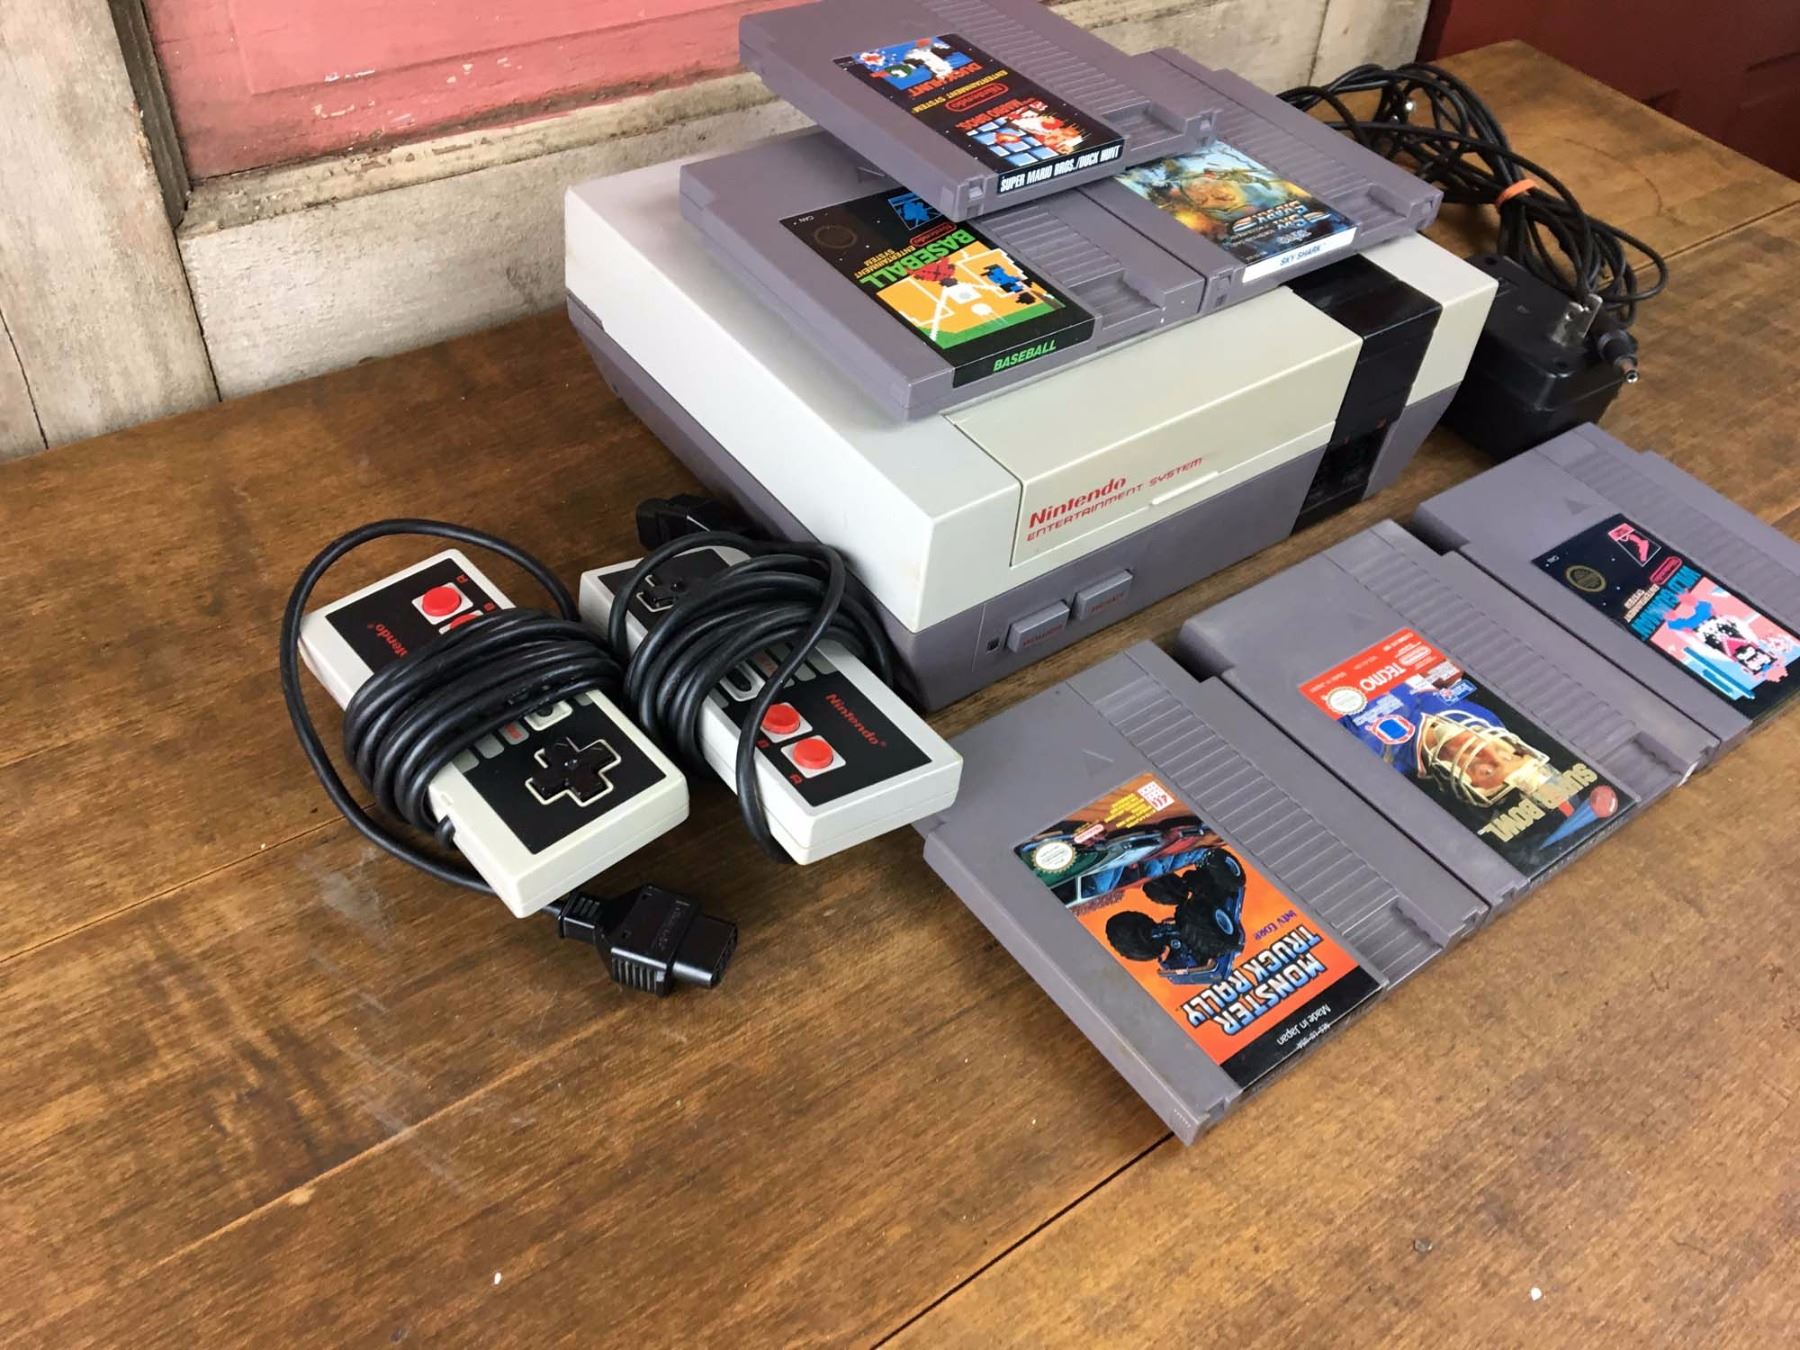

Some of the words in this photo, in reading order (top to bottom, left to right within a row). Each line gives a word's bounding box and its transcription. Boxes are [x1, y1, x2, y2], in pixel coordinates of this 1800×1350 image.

[947, 70, 1009, 97] ENTERTAINMENT
[912, 97, 947, 114] SYSTEM
[984, 99, 1023, 119] MARIO
[1000, 175, 1026, 193] SUPER
[1026, 165, 1053, 185] MARIO
[1100, 145, 1121, 164] HUNT
[853, 245, 916, 279] ENTERTAINMENT
[858, 228, 976, 289] BASEBALL
[864, 249, 896, 266] SYSTEM
[1280, 254, 1295, 266] SKY
[1297, 246, 1320, 259] SHARK
[992, 339, 1057, 373] BASEBALL
[1026, 484, 1144, 542] ENTERTAINMENT
[1149, 457, 1203, 487] SYSTEM
[1028, 477, 1128, 529] Nintendo
[1359, 662, 1407, 692] TECMO
[825, 692, 879, 746] Nintendo
[1483, 799, 1546, 843] BOWL
[1241, 924, 1324, 982] TRUCK
[1180, 968, 1253, 1029] RALLY
[1213, 951, 1328, 1036] MONSTER
[1297, 1016, 1310, 1029] in
[1307, 1003, 1332, 1023] Made
[1276, 1025, 1299, 1046] Japan
